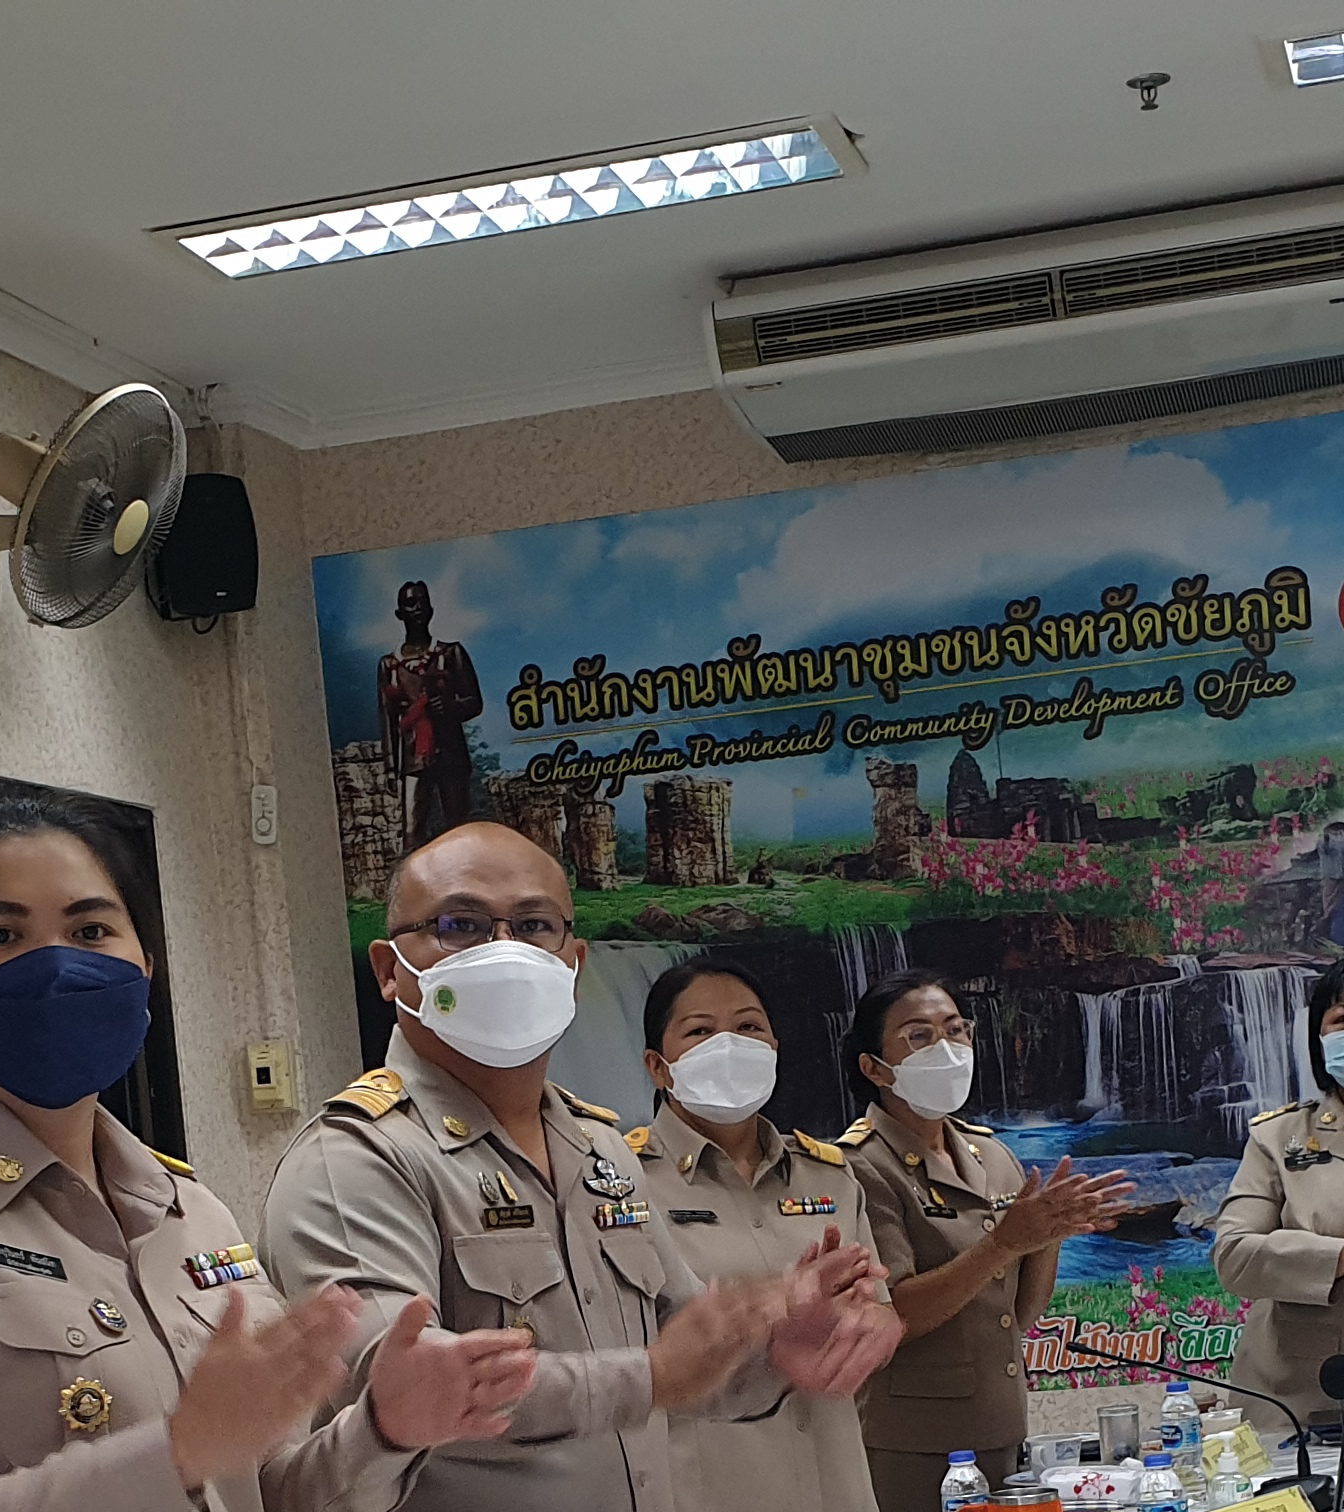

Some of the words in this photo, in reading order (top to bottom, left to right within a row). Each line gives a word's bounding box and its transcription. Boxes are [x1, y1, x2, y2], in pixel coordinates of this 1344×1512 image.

[510, 568, 1309, 728] สำนักงานพัฒนาชุมชนจังหวัดชัยภูมิ
[529, 731, 684, 796] Chaiyaphum
[690, 712, 832, 763] Provincial
[845, 707, 995, 749] Community
[1004, 678, 1182, 739] Development
[1198, 661, 1294, 719] Office
[1171, 1311, 1245, 1362] ลือ
